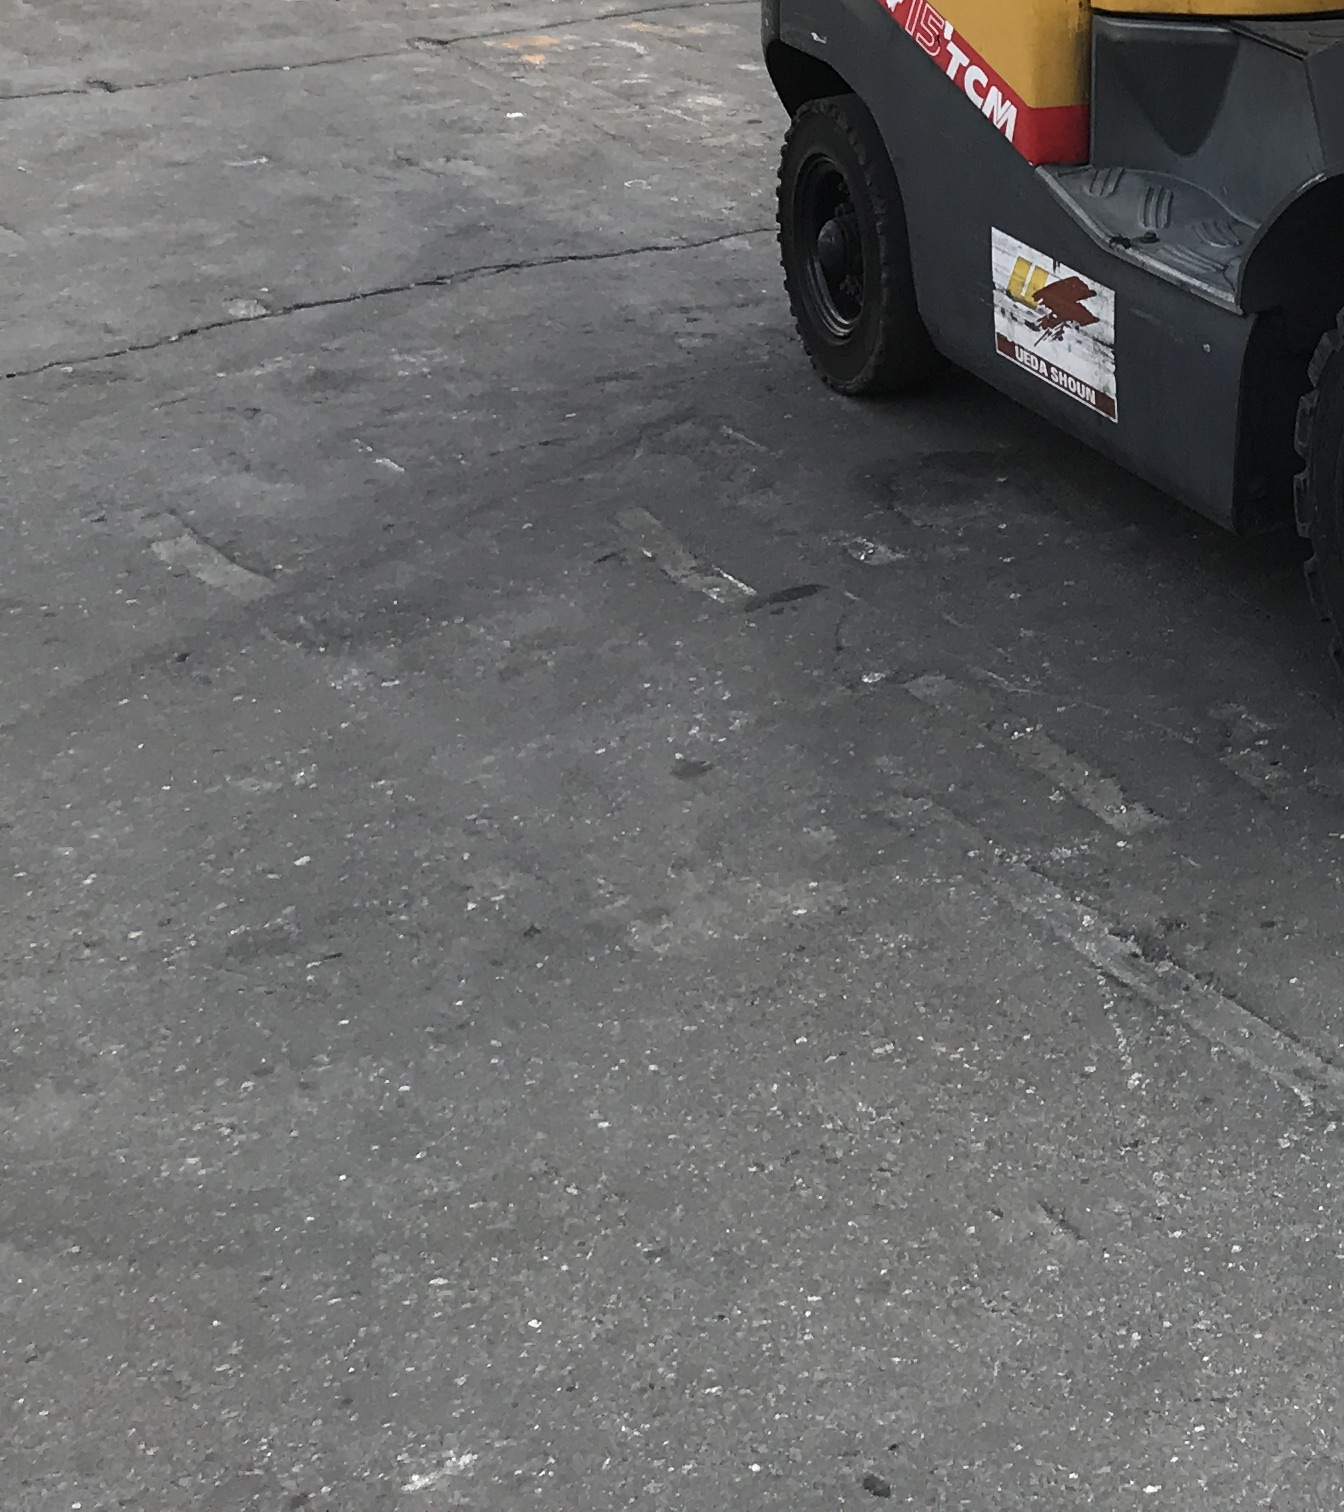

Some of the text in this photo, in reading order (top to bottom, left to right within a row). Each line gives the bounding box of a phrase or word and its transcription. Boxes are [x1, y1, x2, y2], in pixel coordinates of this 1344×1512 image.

[945, 41, 1018, 143] TCM
[1014, 345, 1096, 406] UEDA SHOUN
